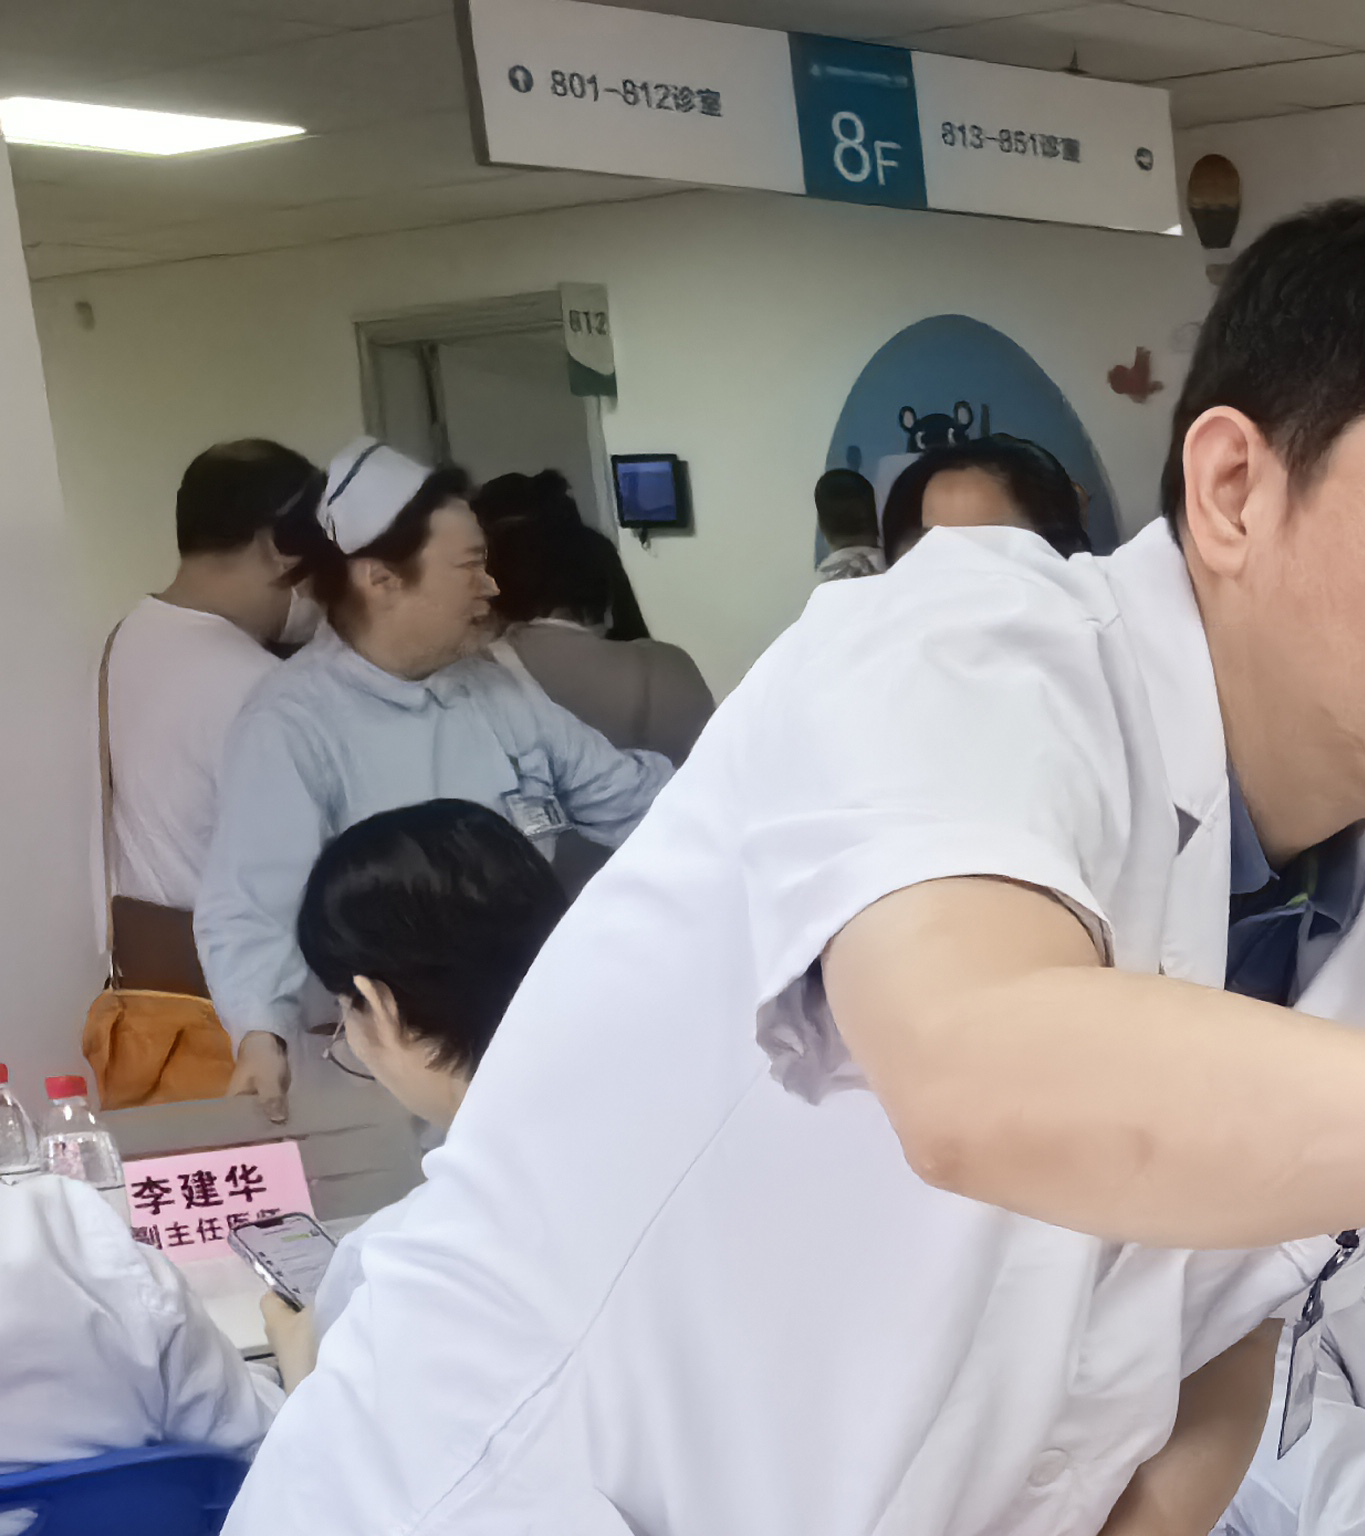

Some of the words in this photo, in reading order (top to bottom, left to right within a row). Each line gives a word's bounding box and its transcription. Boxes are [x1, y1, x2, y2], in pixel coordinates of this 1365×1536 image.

[831, 111, 901, 186] 8F
[131, 1163, 267, 1215] 李建华
